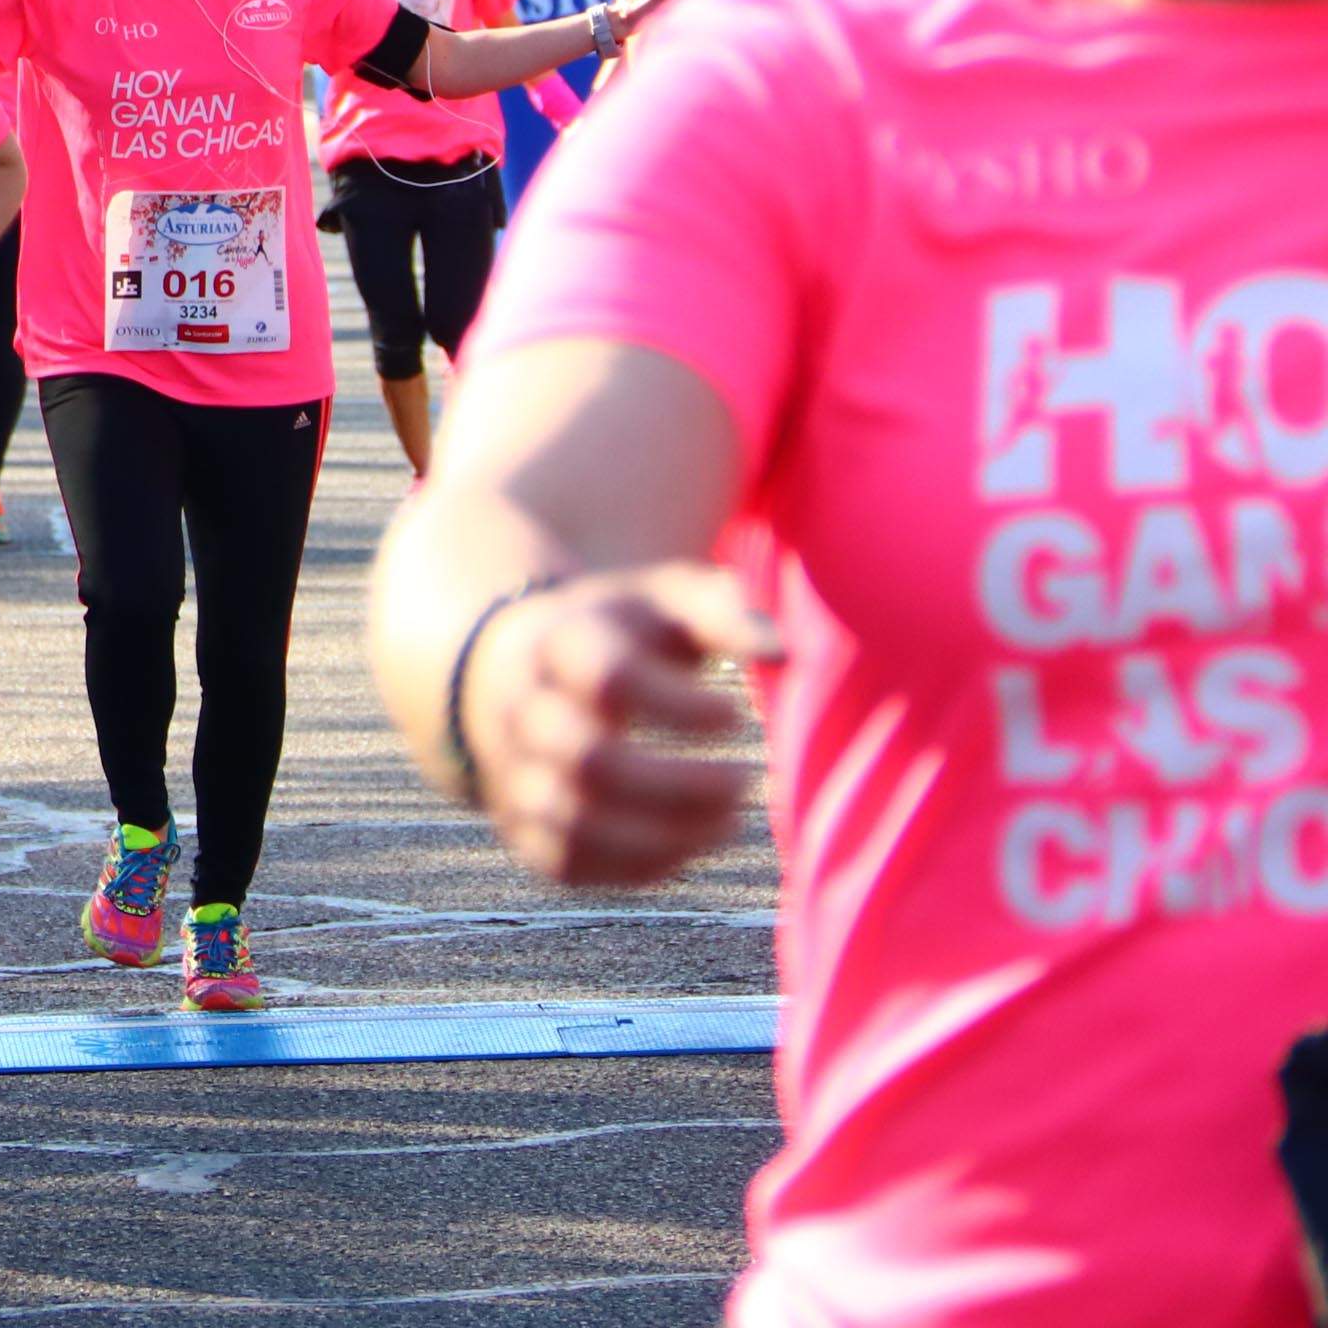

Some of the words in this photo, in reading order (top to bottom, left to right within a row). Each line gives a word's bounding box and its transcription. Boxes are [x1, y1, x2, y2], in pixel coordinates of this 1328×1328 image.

[95, 16, 158, 40] OYHO
[111, 69, 182, 100] HOY
[111, 93, 235, 128] GANAN
[111, 130, 167, 159] LAS
[176, 117, 285, 159] CHICAS
[163, 217, 238, 234] ASTURIANA
[162, 269, 235, 298] 016
[180, 305, 218, 319] 3234
[116, 325, 160, 337] OYSHO
[977, 271, 1328, 504] HO
[974, 497, 1328, 648] GAN
